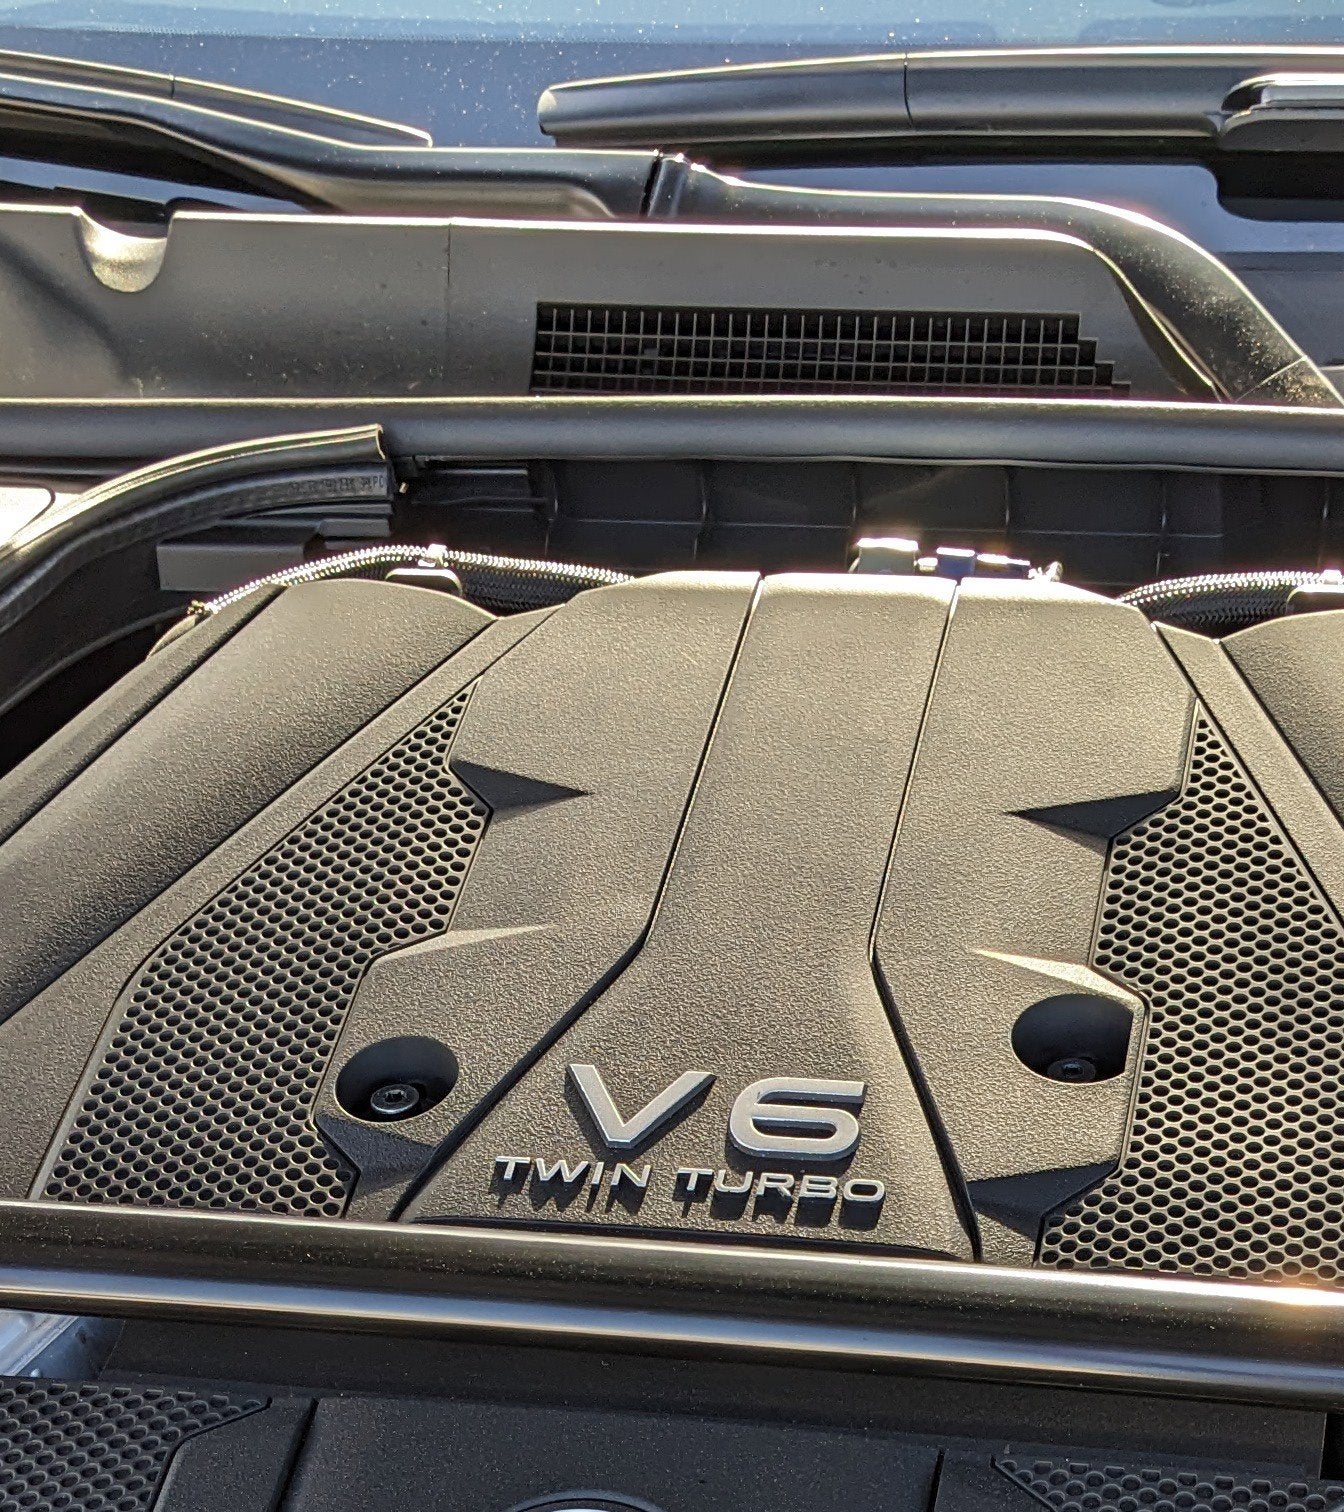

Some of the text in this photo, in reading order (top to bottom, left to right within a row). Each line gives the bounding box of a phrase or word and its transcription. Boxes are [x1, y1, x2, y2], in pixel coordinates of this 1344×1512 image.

[568, 1063, 868, 1161] V6
[495, 1156, 885, 1202] TWIN TURBO
